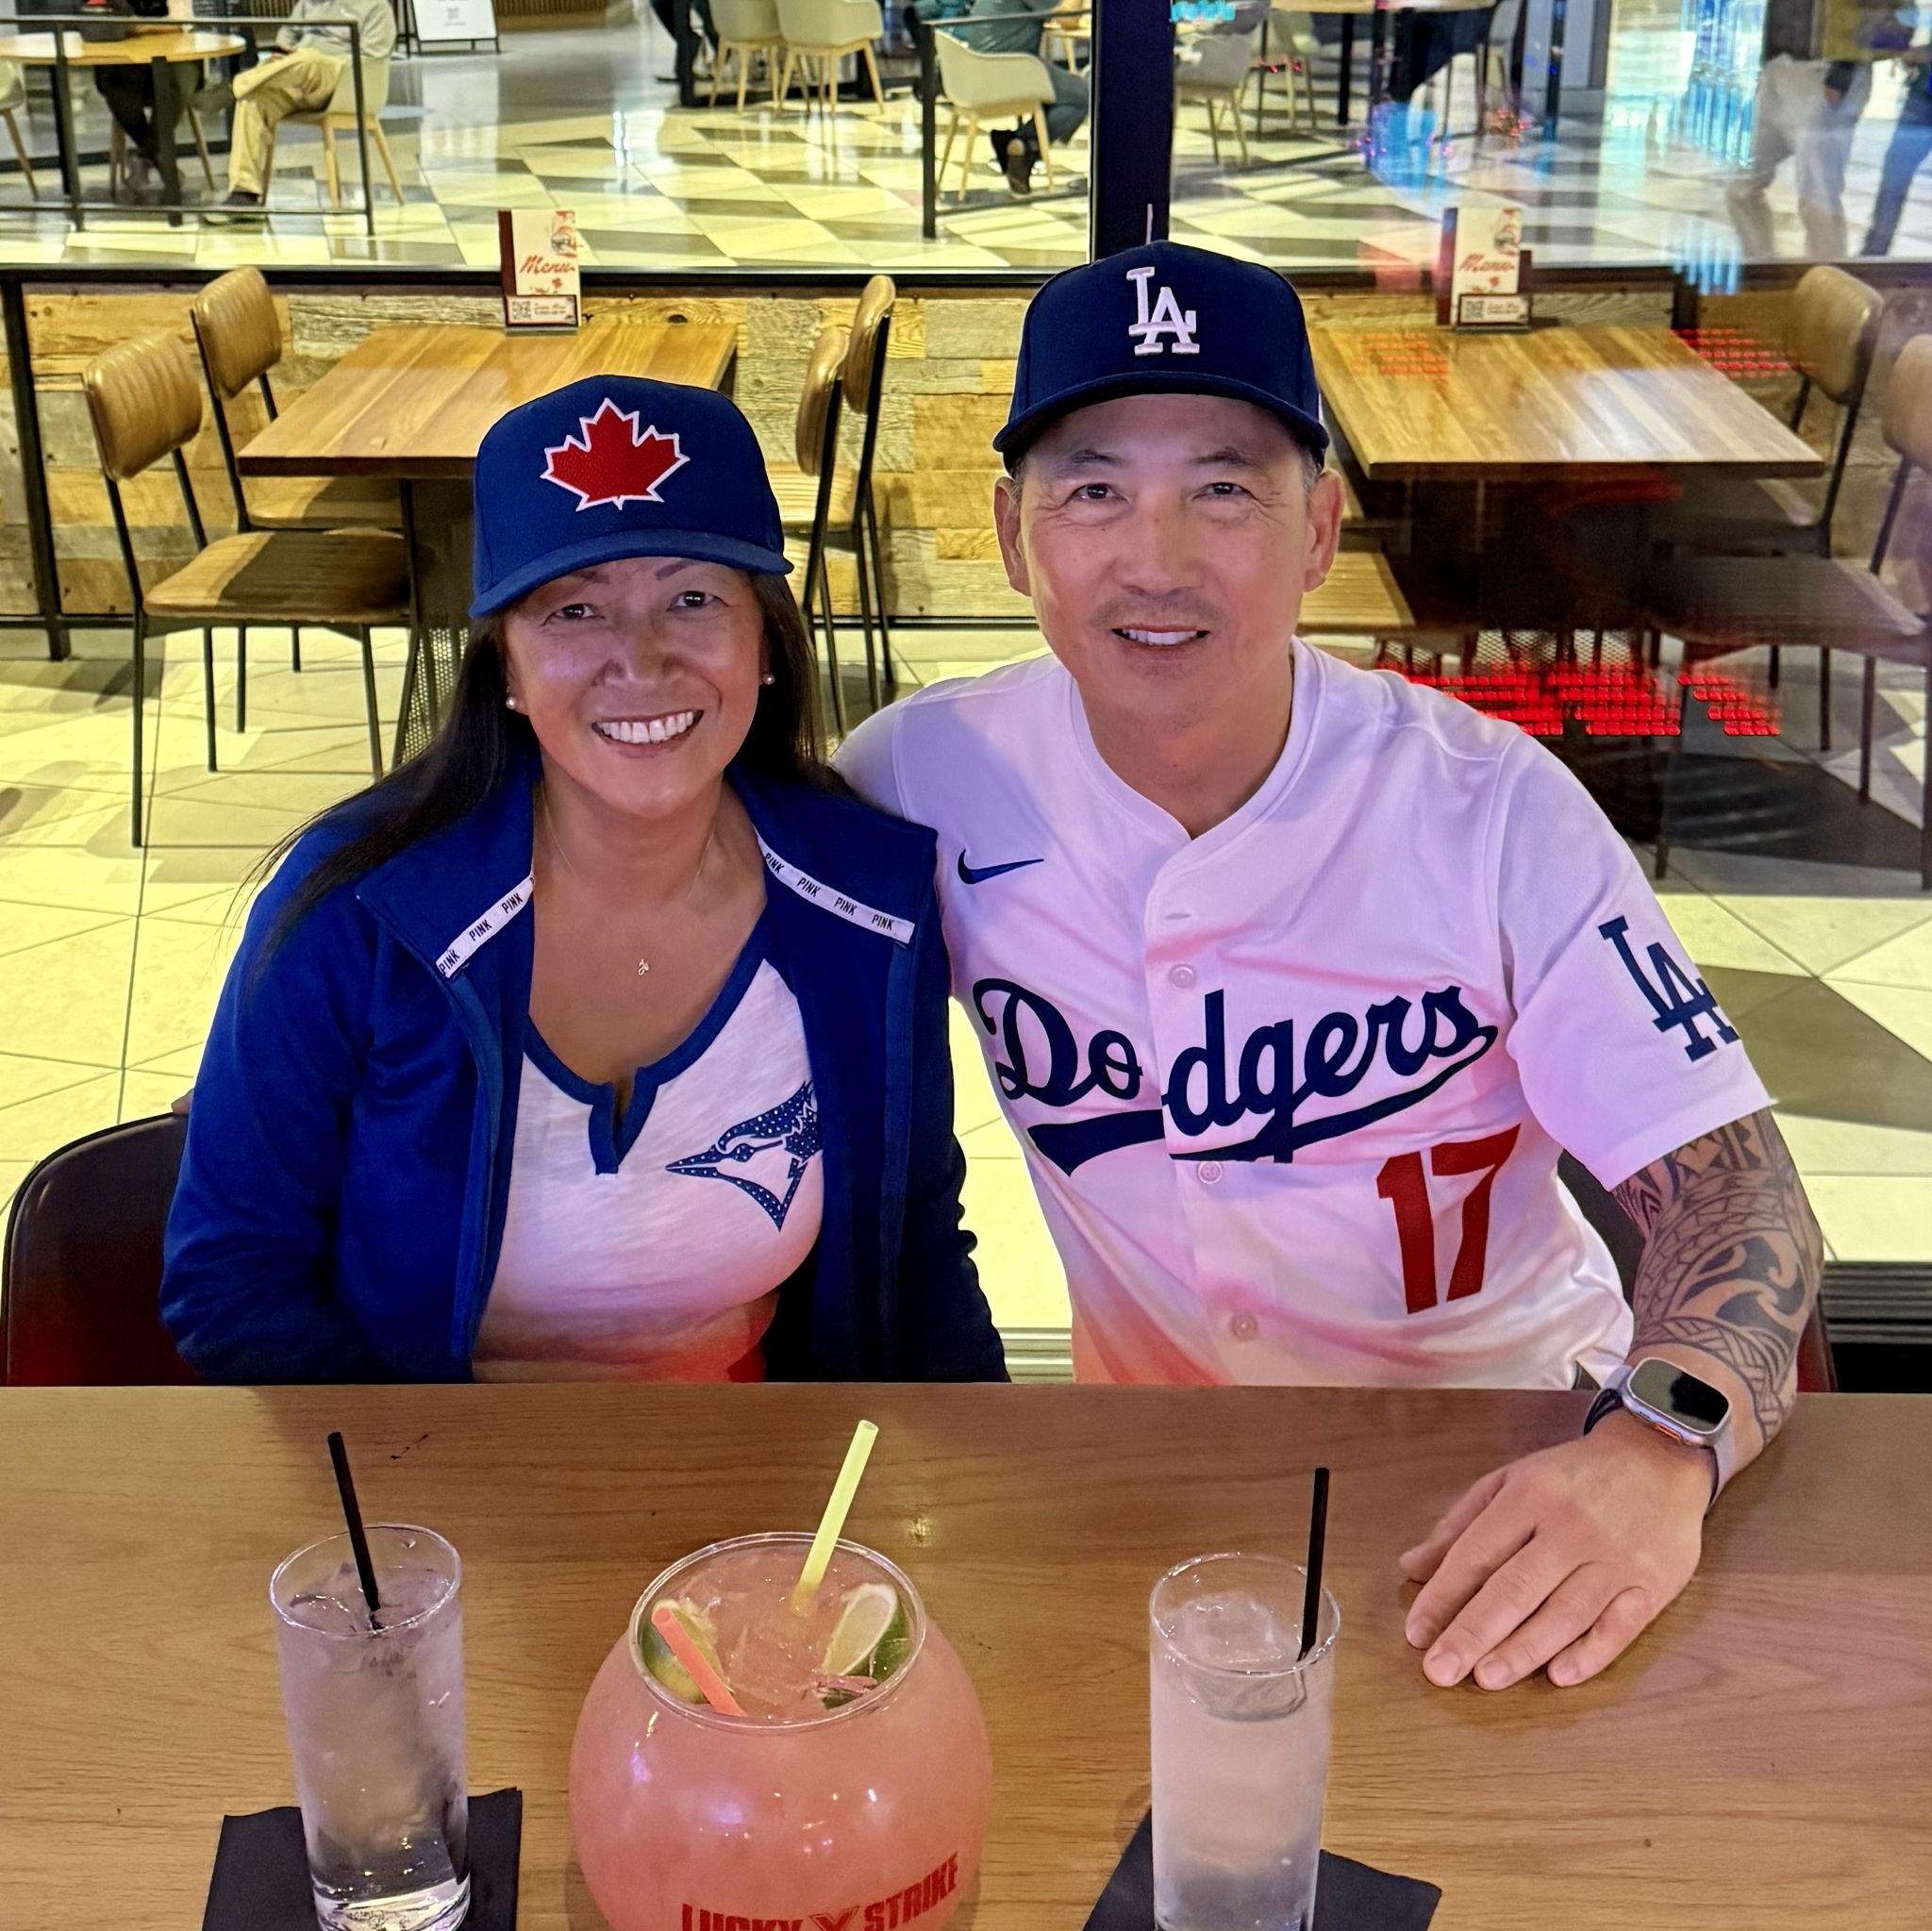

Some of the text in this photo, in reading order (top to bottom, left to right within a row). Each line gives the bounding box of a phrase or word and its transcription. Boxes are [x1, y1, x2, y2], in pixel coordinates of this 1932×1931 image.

[520, 255, 575, 274] Menu
[1126, 266, 1200, 356] LA
[439, 892, 524, 976] PINK PINK PINK
[796, 877, 821, 897] PINK
[834, 897, 858, 916] PINK
[872, 914, 895, 930] PINK
[1598, 915, 1740, 1062] LA
[973, 977, 1498, 1164] Dodgers
[1376, 1123, 1521, 1315] 17
[864, 1851, 958, 1931] STRIKE
